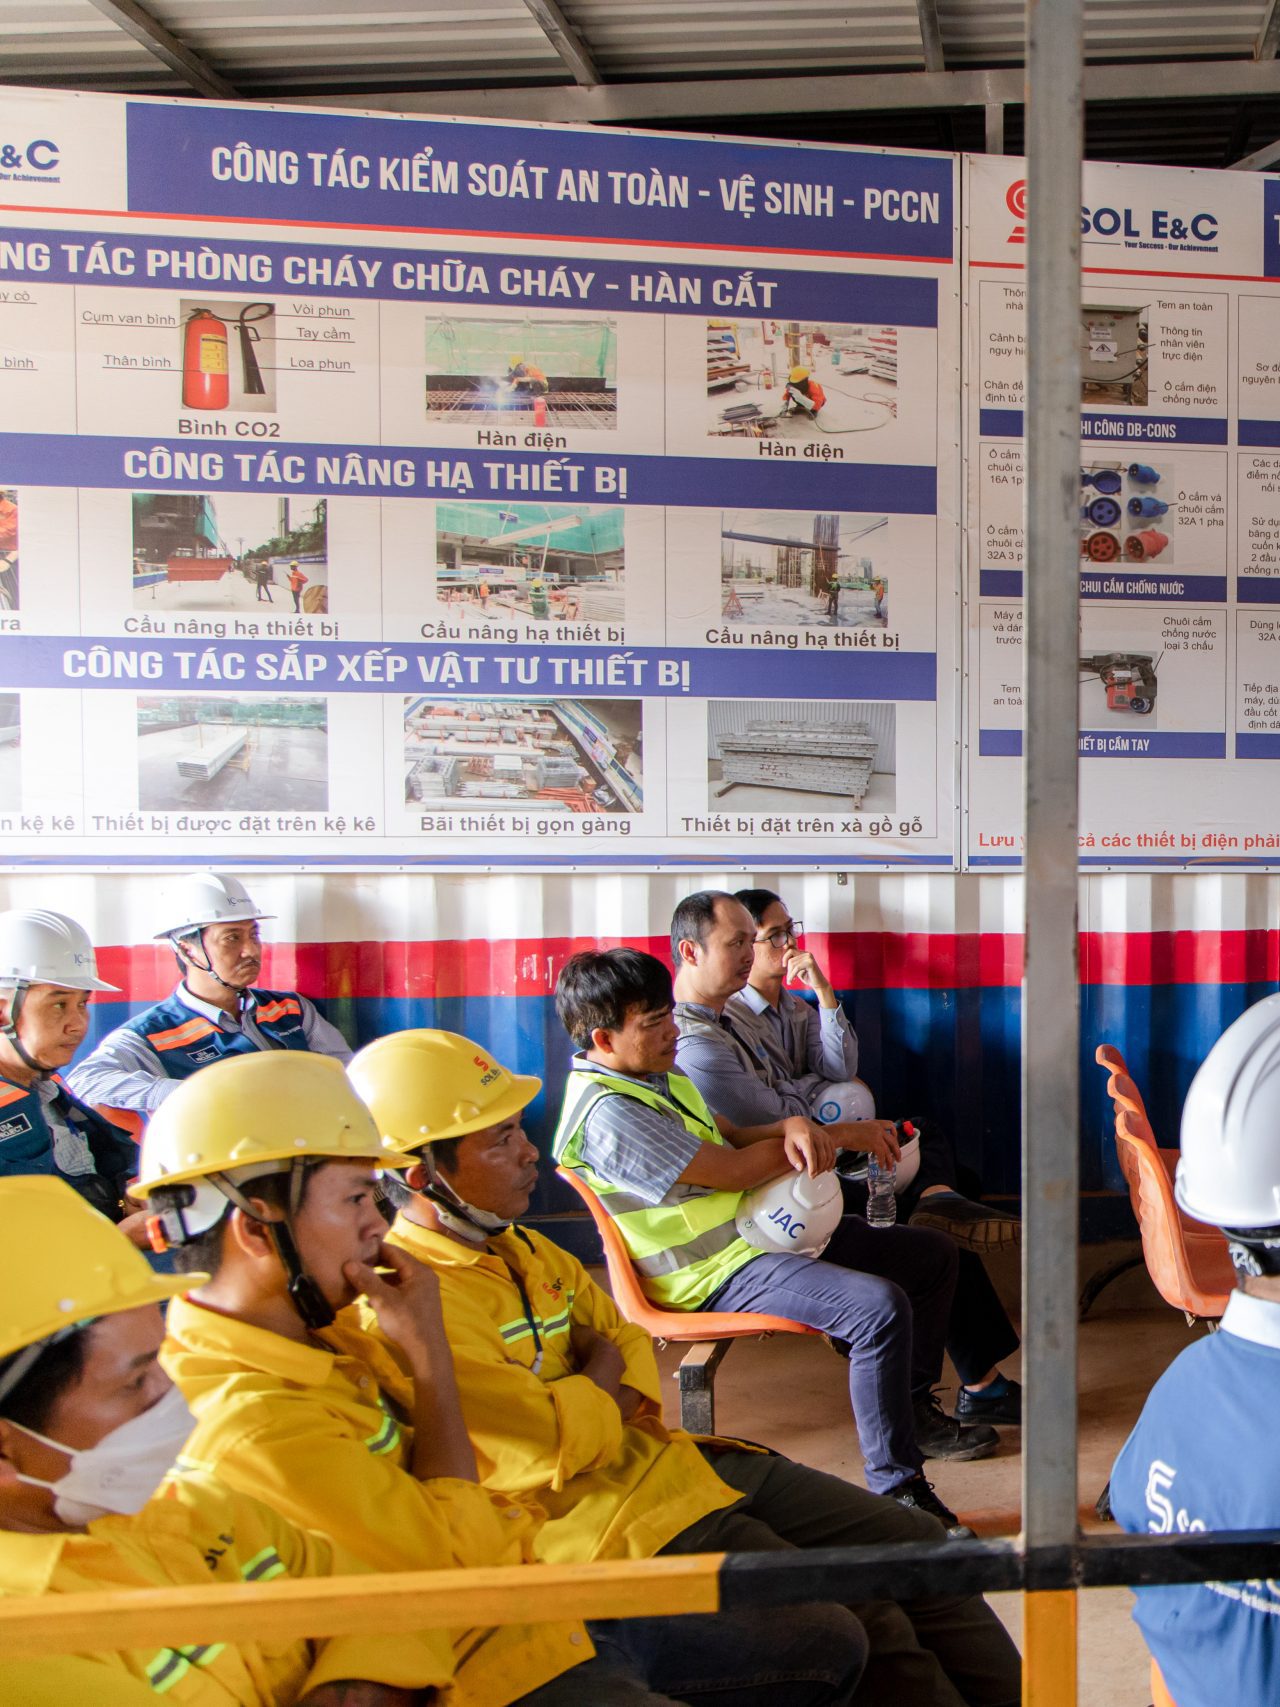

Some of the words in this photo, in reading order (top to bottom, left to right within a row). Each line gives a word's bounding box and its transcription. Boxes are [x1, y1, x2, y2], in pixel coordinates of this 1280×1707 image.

[212, 142, 299, 185] CÔNG
[308, 148, 370, 189] TÁC
[380, 146, 458, 195] KIỂM
[468, 160, 548, 200] SOÁT
[557, 168, 598, 201] AN
[608, 168, 688, 208] TOÀN
[719, 174, 755, 218] VỆ
[765, 182, 834, 217] SINH
[865, 189, 939, 224] PCCN
[1152, 211, 1218, 242] E&C
[61, 240, 135, 276] TÁC
[147, 246, 272, 282] PHÒNG
[284, 254, 382, 288] CHÁY
[393, 259, 490, 294] CHỮA
[500, 265, 595, 299] CHÁY
[631, 271, 701, 304] HÀN
[713, 271, 778, 308] CẮT
[293, 304, 314, 317] Vòi
[318, 305, 351, 319] phun
[1157, 300, 1176, 309] Tem
[1193, 303, 1212, 311] toàn
[82, 310, 113, 326] Cụm
[118, 315, 143, 324] van
[148, 313, 176, 325] bình
[297, 327, 321, 342] Tay
[1160, 327, 1188, 337] Thông
[1160, 339, 1183, 348] nhân
[104, 354, 139, 367] Thân
[143, 356, 171, 368] bình
[290, 357, 314, 369] Loa
[318, 359, 351, 371] phun
[1184, 353, 1202, 361] điện
[178, 419, 227, 436] Bình
[235, 421, 280, 438] CO2
[478, 430, 518, 447] Hàn
[525, 432, 566, 451] điện
[759, 441, 797, 457] Hàn
[803, 443, 844, 461] điện
[124, 446, 224, 481] CÔNG
[233, 450, 305, 483] TÁC
[317, 452, 415, 486] NÂNG
[427, 461, 474, 494] HẠ
[484, 458, 584, 492] THIẾT
[595, 467, 627, 499] BỊ
[124, 614, 165, 634] Cẩu
[174, 619, 226, 639] nâng
[234, 619, 259, 640] hạ
[267, 618, 313, 636] thiết
[321, 621, 338, 640] bị
[1164, 641, 1179, 651] loại
[63, 645, 163, 679] CÔNG
[173, 647, 245, 680] TÁC
[256, 644, 326, 681] SẮP
[337, 648, 407, 682] XẾP
[418, 651, 485, 688] VẬT
[494, 657, 540, 685] TƯ
[548, 652, 648, 686] THIẾT
[658, 660, 690, 692] BỊ
[682, 815, 730, 832] Thiết
[738, 817, 754, 835] bị
[761, 817, 791, 835] đặt
[797, 817, 834, 833] trên
[841, 817, 862, 833] xà
[869, 815, 892, 835] gồ
[899, 815, 922, 836] gỗ
[1101, 833, 1131, 848] các
[1137, 830, 1173, 848] thiết
[1180, 833, 1196, 850] bị
[1202, 833, 1238, 850] điện
[1244, 833, 1280, 851] phải
[768, 1207, 806, 1239] JAC
